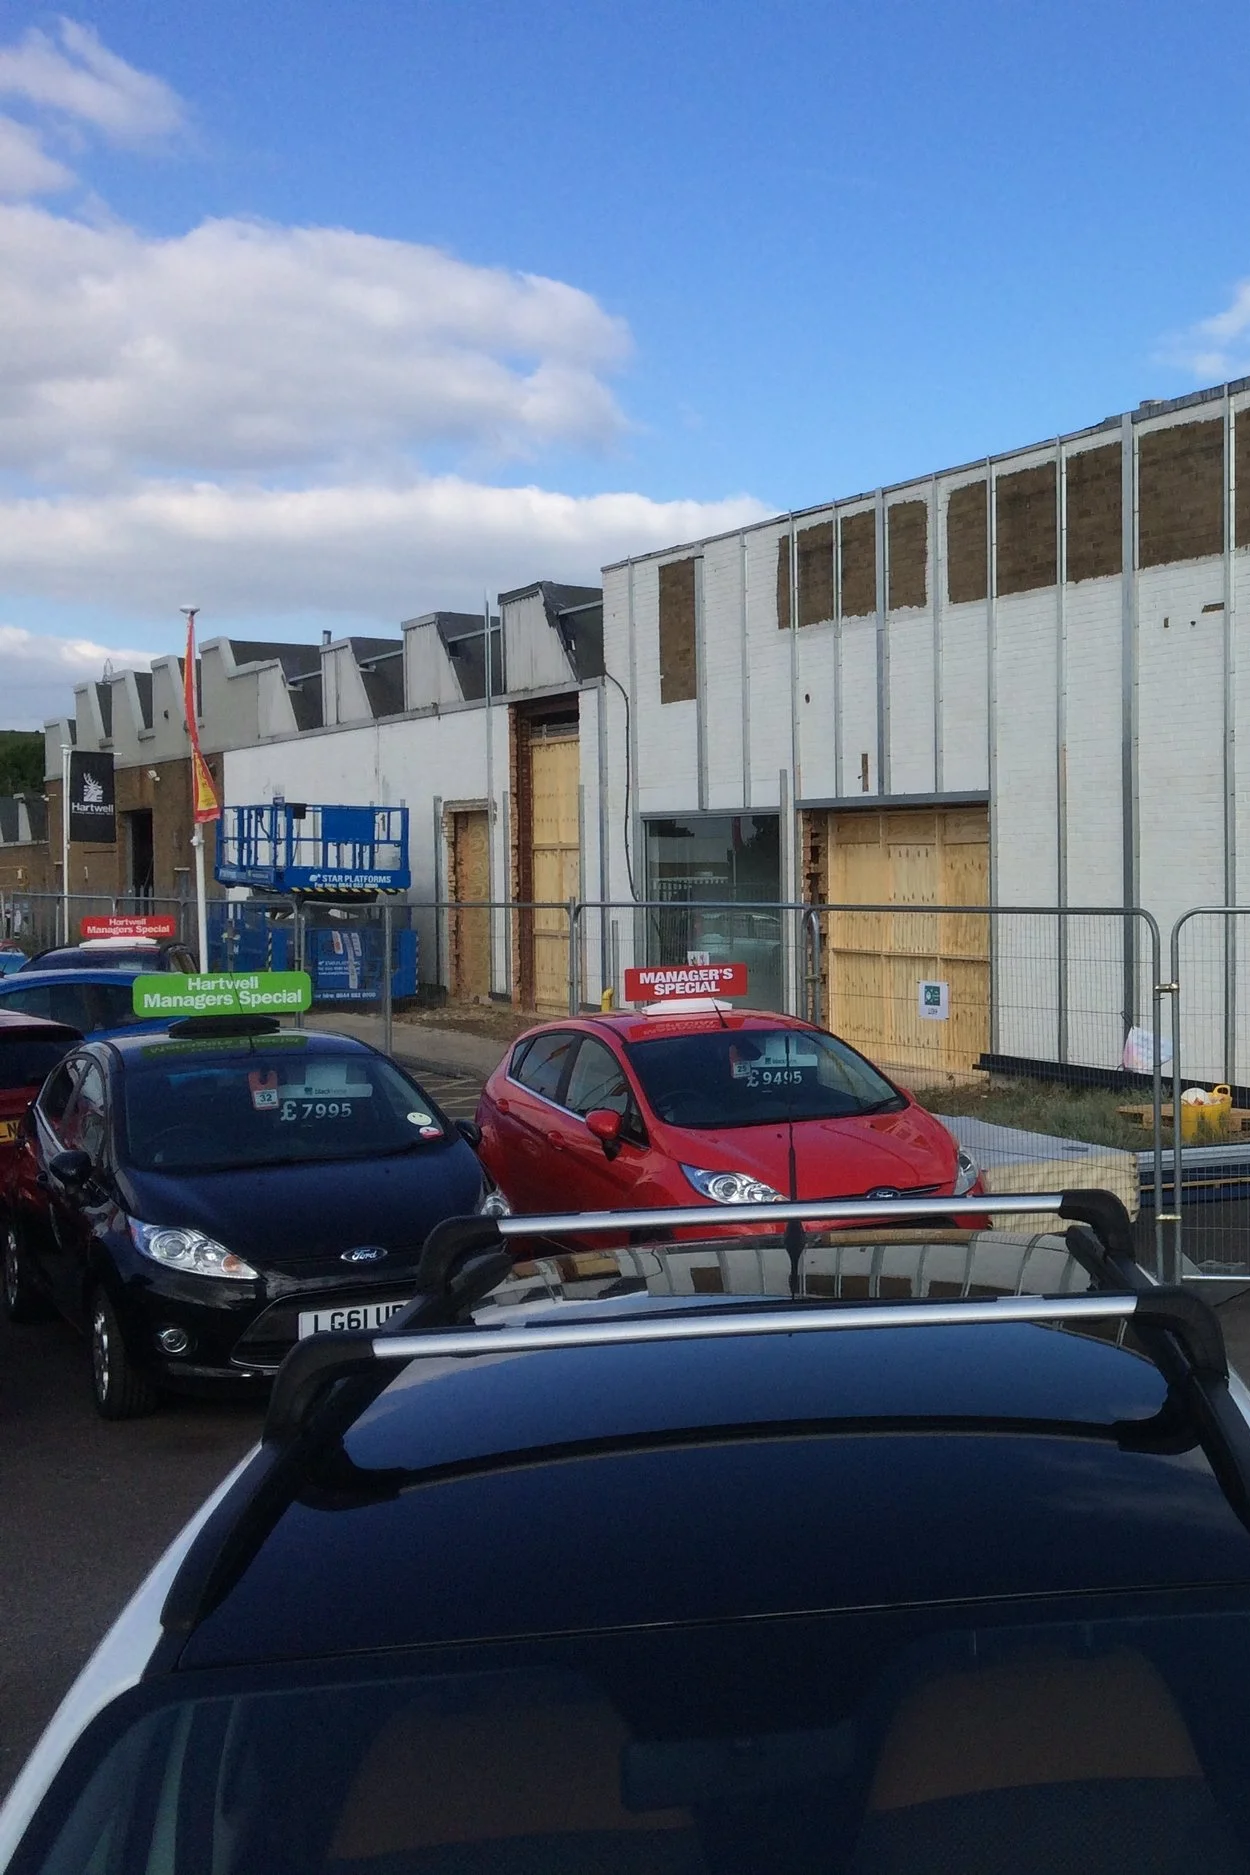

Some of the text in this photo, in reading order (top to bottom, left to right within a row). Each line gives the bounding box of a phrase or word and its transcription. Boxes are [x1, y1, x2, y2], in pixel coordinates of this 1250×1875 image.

[71, 802, 114, 814] Hartwell
[322, 874, 391, 884] STAR PLATFORMS
[108, 918, 147, 927] Hartwell
[87, 925, 170, 935] Managers Special
[639, 968, 734, 985] MANAGER'S
[187, 975, 259, 991] Hartwell
[654, 981, 721, 996] SPECIAL
[143, 989, 302, 1010] Managers Special
[259, 1094, 273, 1103] 32
[351, 1250, 377, 1261] Ford
[314, 1308, 368, 1333] LG61
